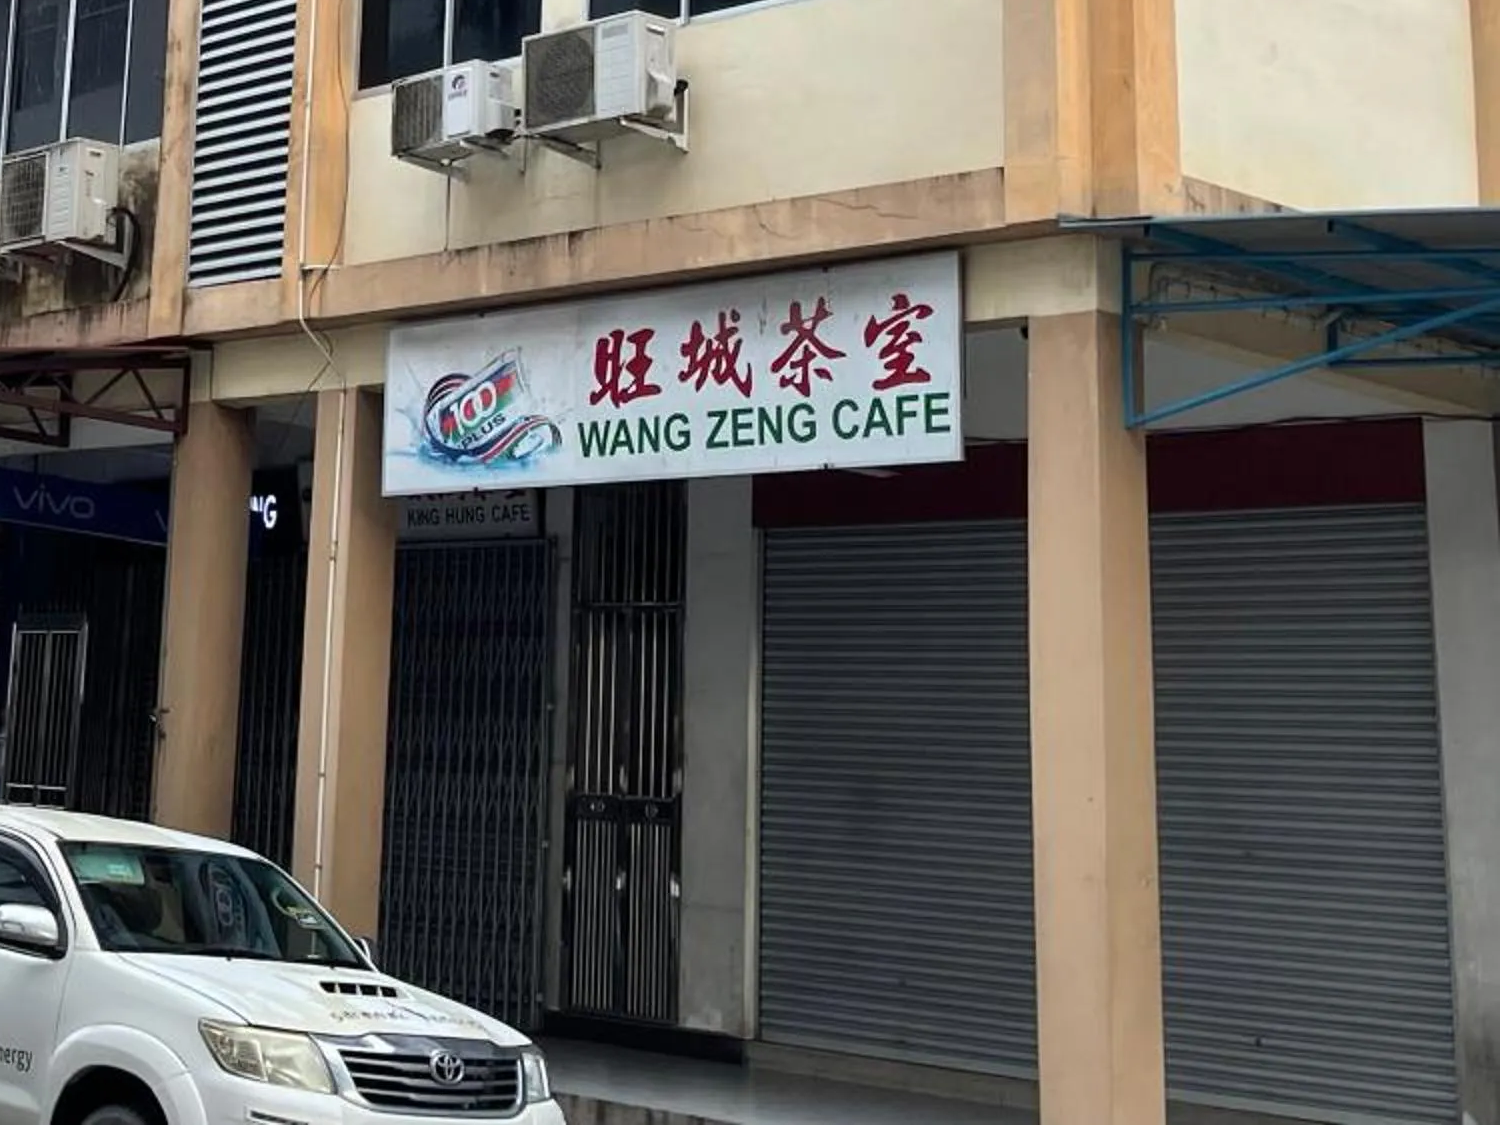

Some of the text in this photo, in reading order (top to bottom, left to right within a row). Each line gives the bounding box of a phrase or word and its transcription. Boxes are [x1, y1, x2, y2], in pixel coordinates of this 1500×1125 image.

[589, 293, 935, 409] 旺城茶室
[450, 380, 497, 436] 100
[460, 412, 507, 449] PLUS
[577, 392, 952, 458] WANG ZENG CAFE
[13, 483, 95, 519] vivo
[445, 505, 485, 525] HUNG
[492, 503, 531, 524] CAFE
